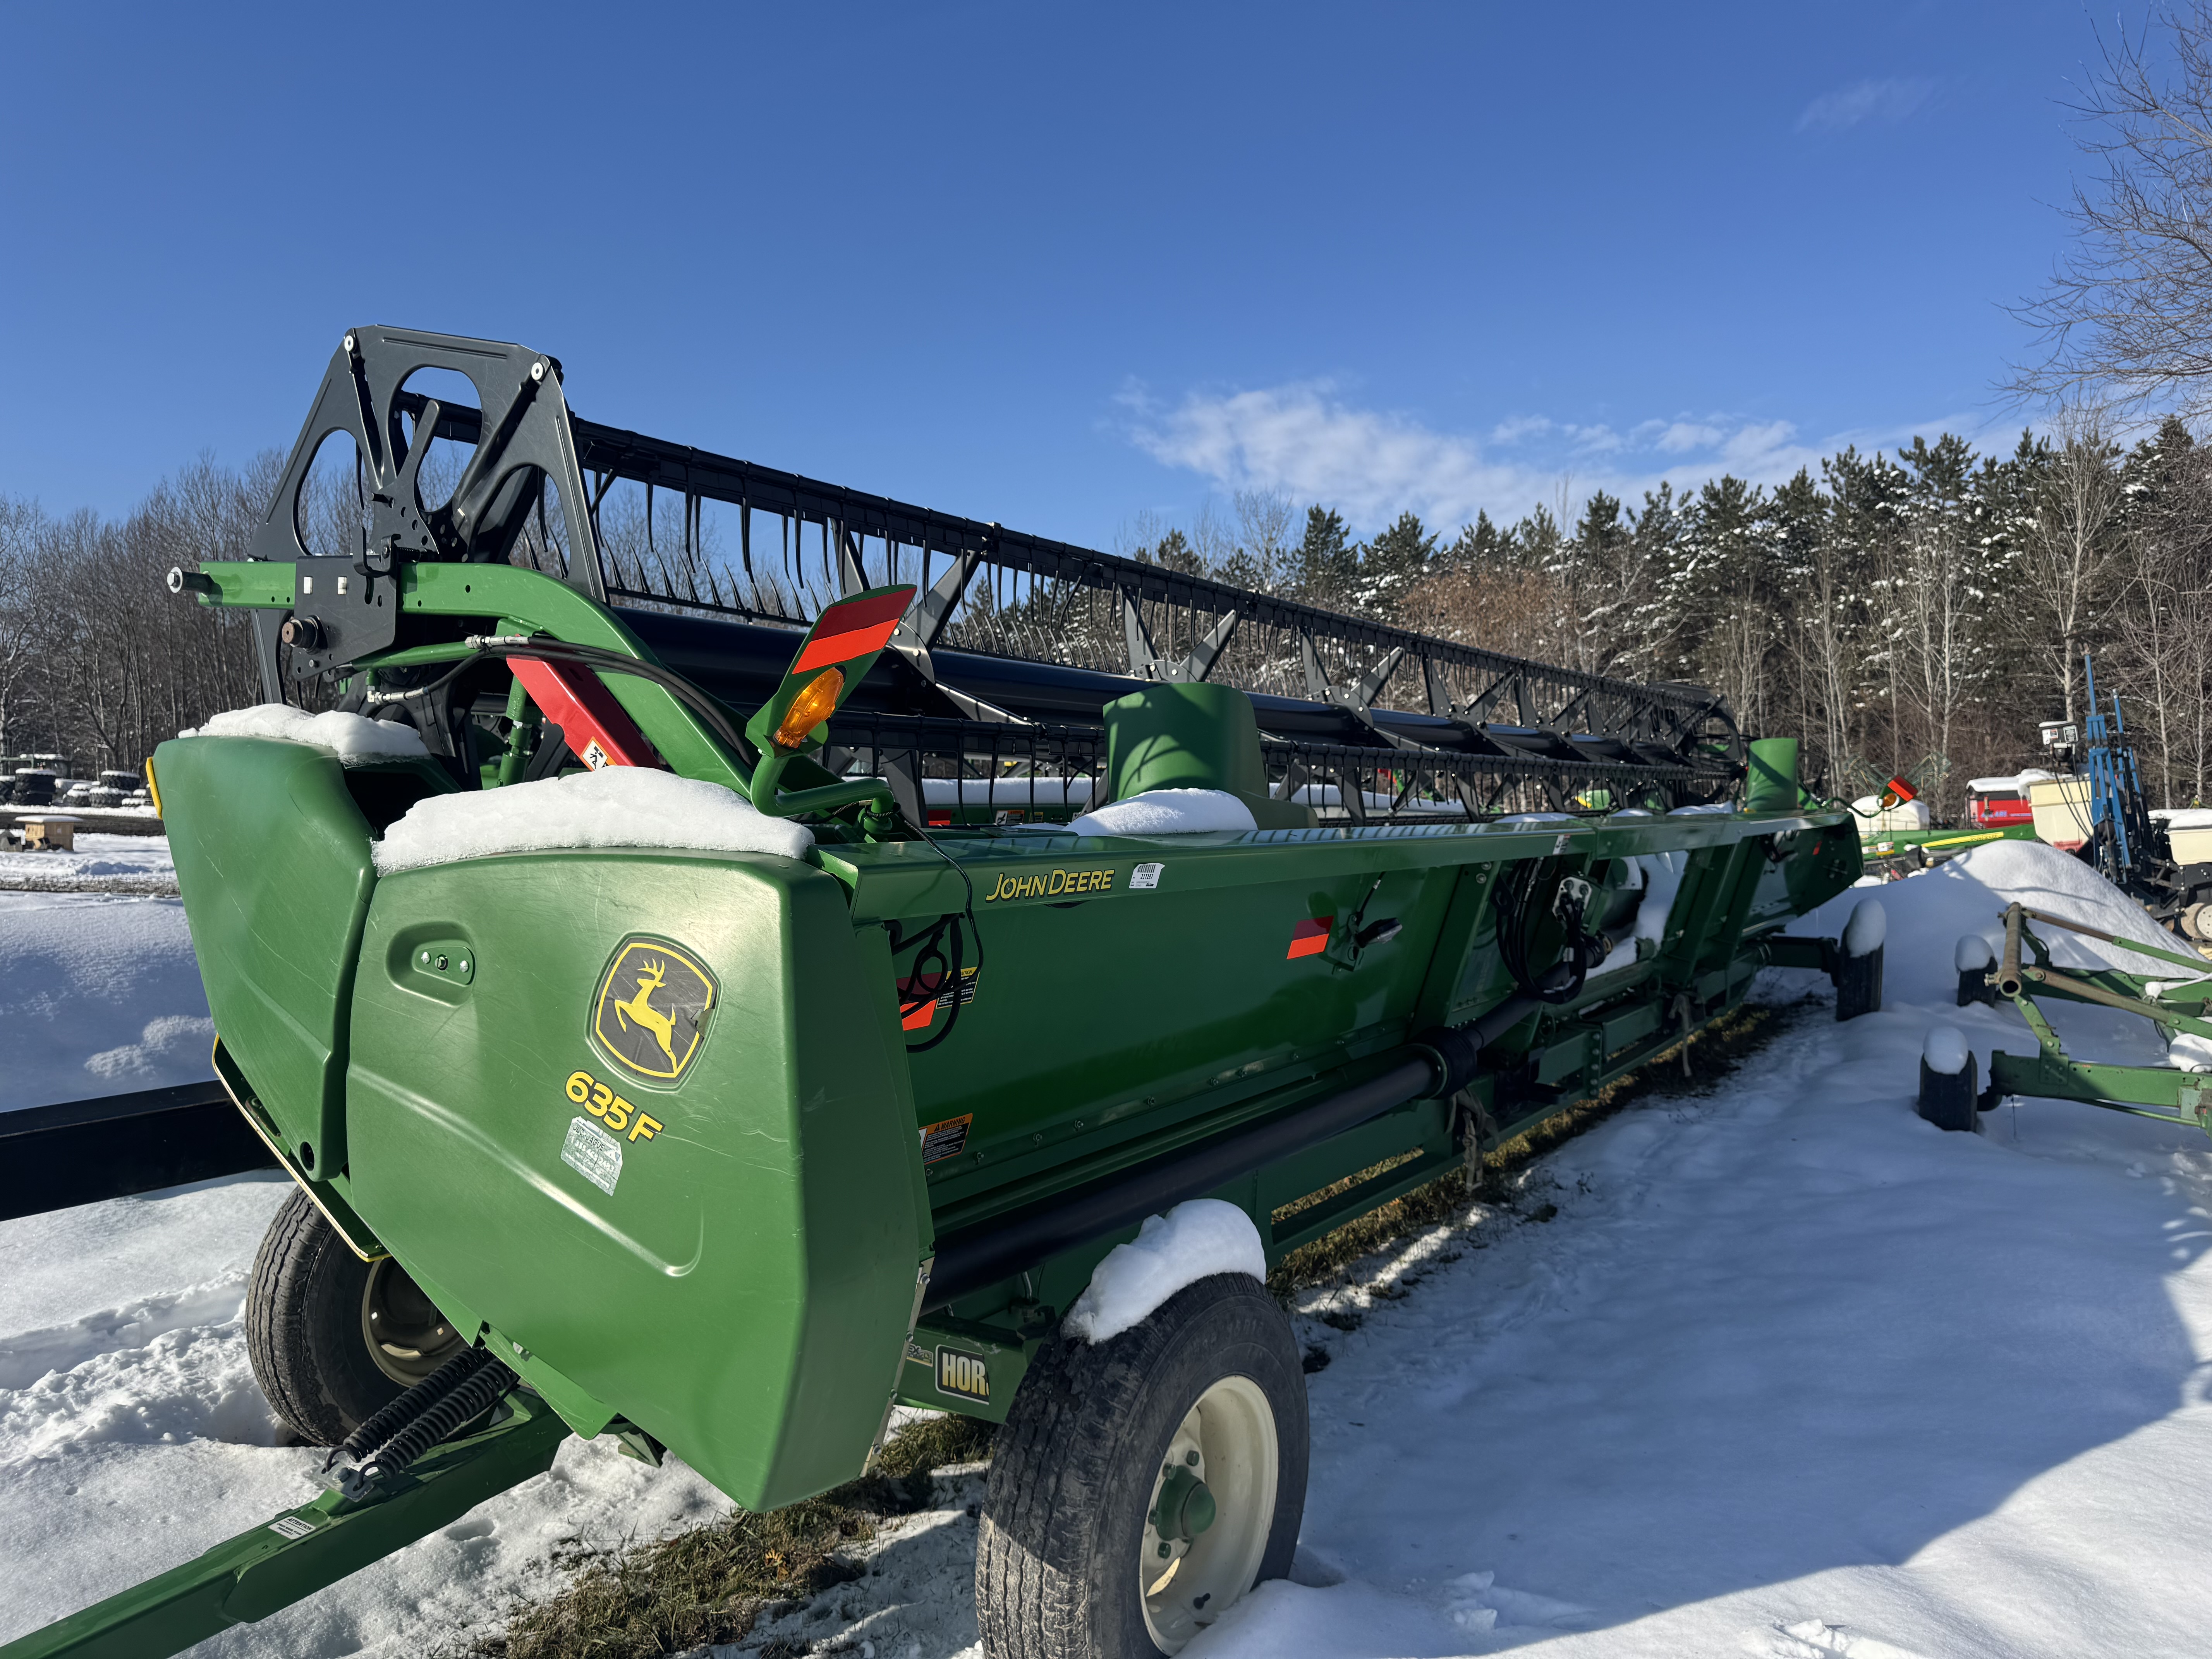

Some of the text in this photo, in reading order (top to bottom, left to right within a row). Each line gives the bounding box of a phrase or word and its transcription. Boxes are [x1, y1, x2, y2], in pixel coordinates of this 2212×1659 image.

[986, 869, 1114, 901] JOHN DEERE
[941, 1117, 965, 1130] WARNING
[942, 1352, 989, 1396] HOR
[287, 1518, 313, 1530] ATTENTION
